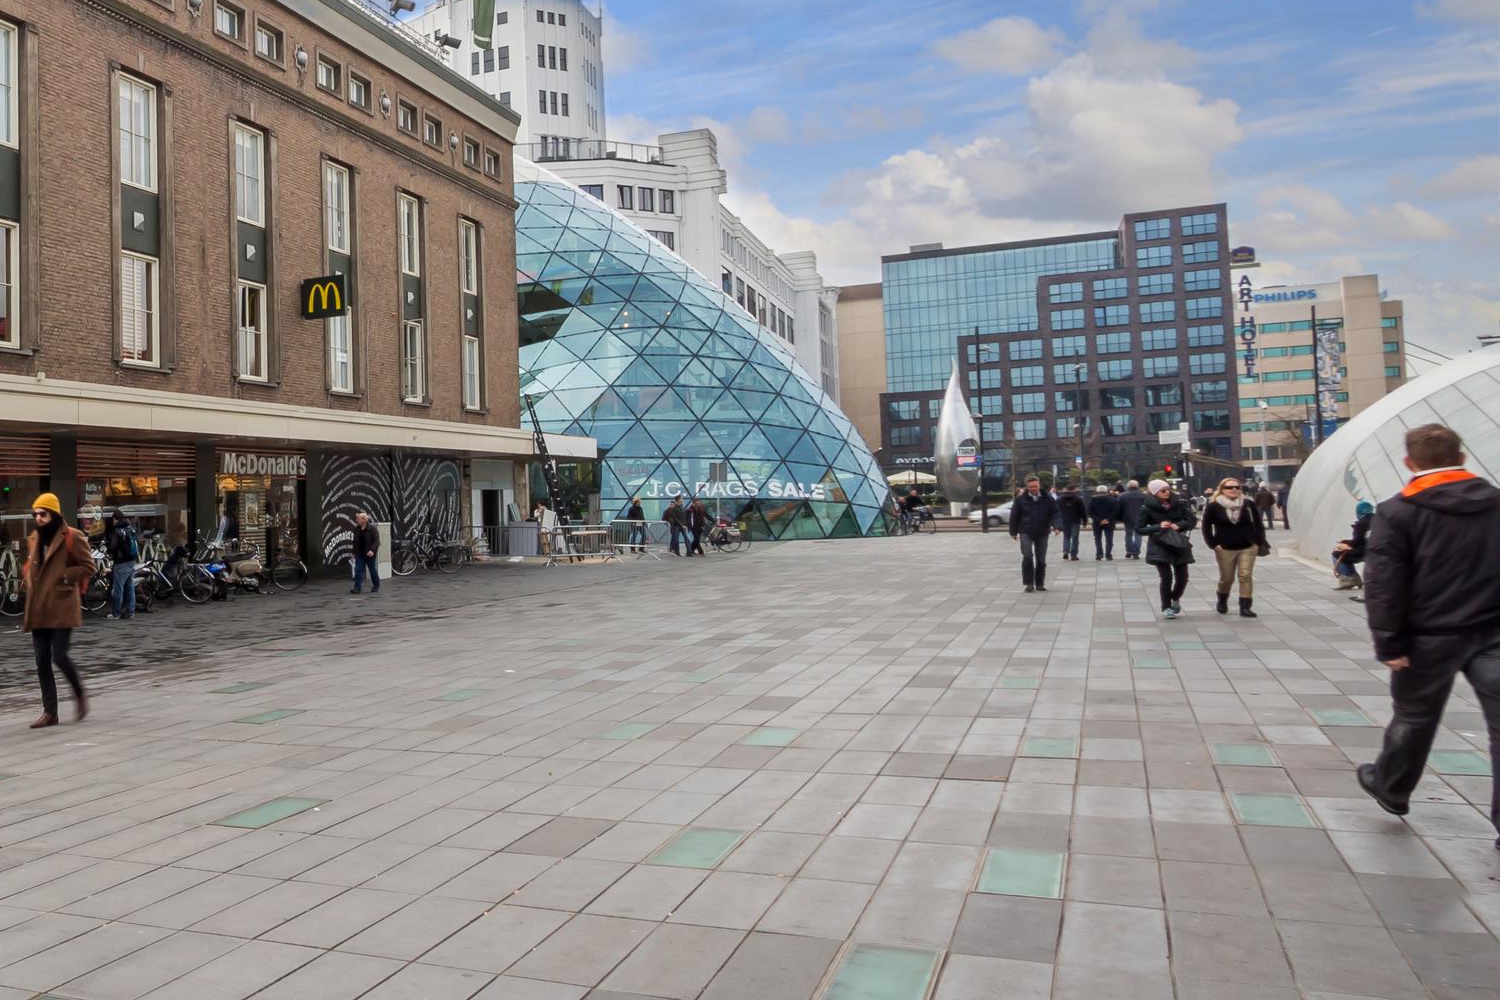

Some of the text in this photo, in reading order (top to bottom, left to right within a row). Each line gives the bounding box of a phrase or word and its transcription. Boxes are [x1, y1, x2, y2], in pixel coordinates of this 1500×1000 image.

[1239, 275, 1252, 312] ART
[1253, 289, 1317, 303] PHILIPS
[1240, 316, 1256, 378] HOTEL
[224, 453, 307, 475] McDonald's
[646, 481, 825, 499] J.C. RAGS SALE
